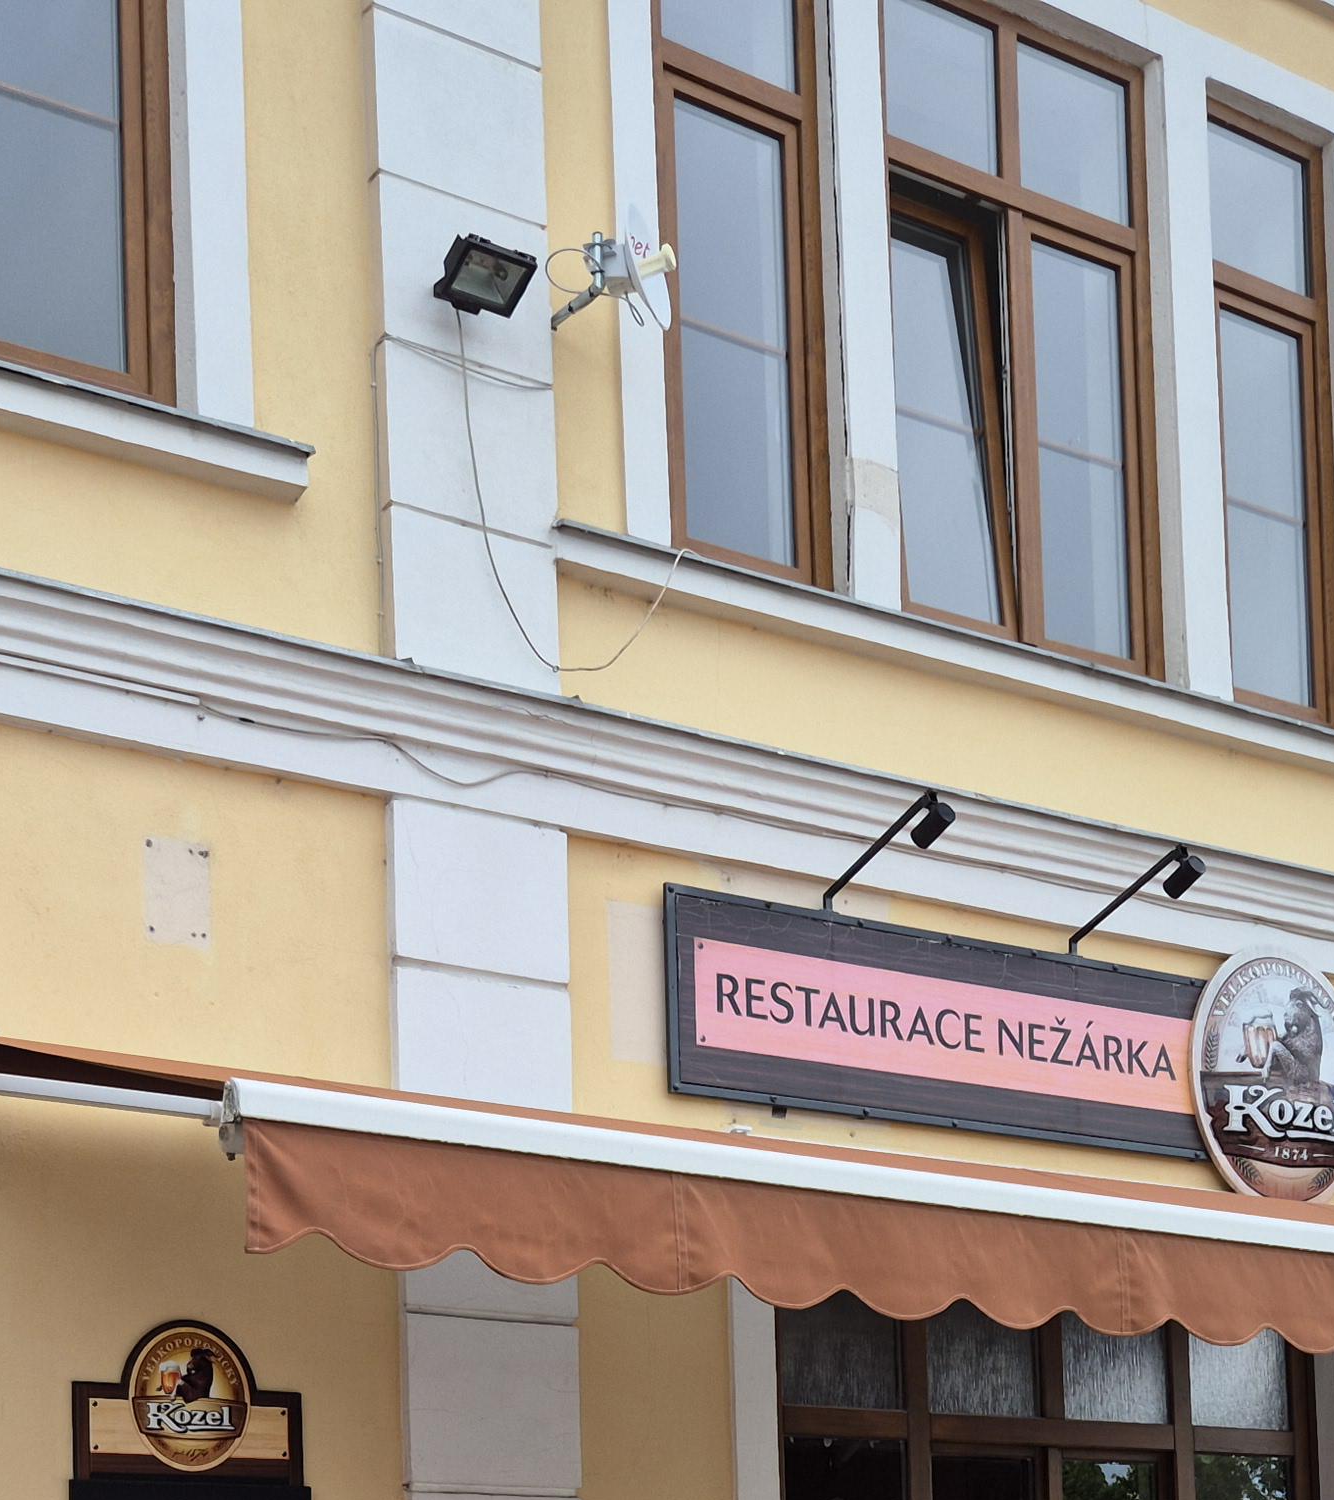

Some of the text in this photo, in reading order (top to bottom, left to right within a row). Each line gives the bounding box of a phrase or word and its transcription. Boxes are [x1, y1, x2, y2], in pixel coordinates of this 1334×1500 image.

[714, 972, 1179, 1082] RESTAURACE NEŽÁRKA
[1273, 1146, 1310, 1161] 1874
[146, 1400, 237, 1439] Kozel
